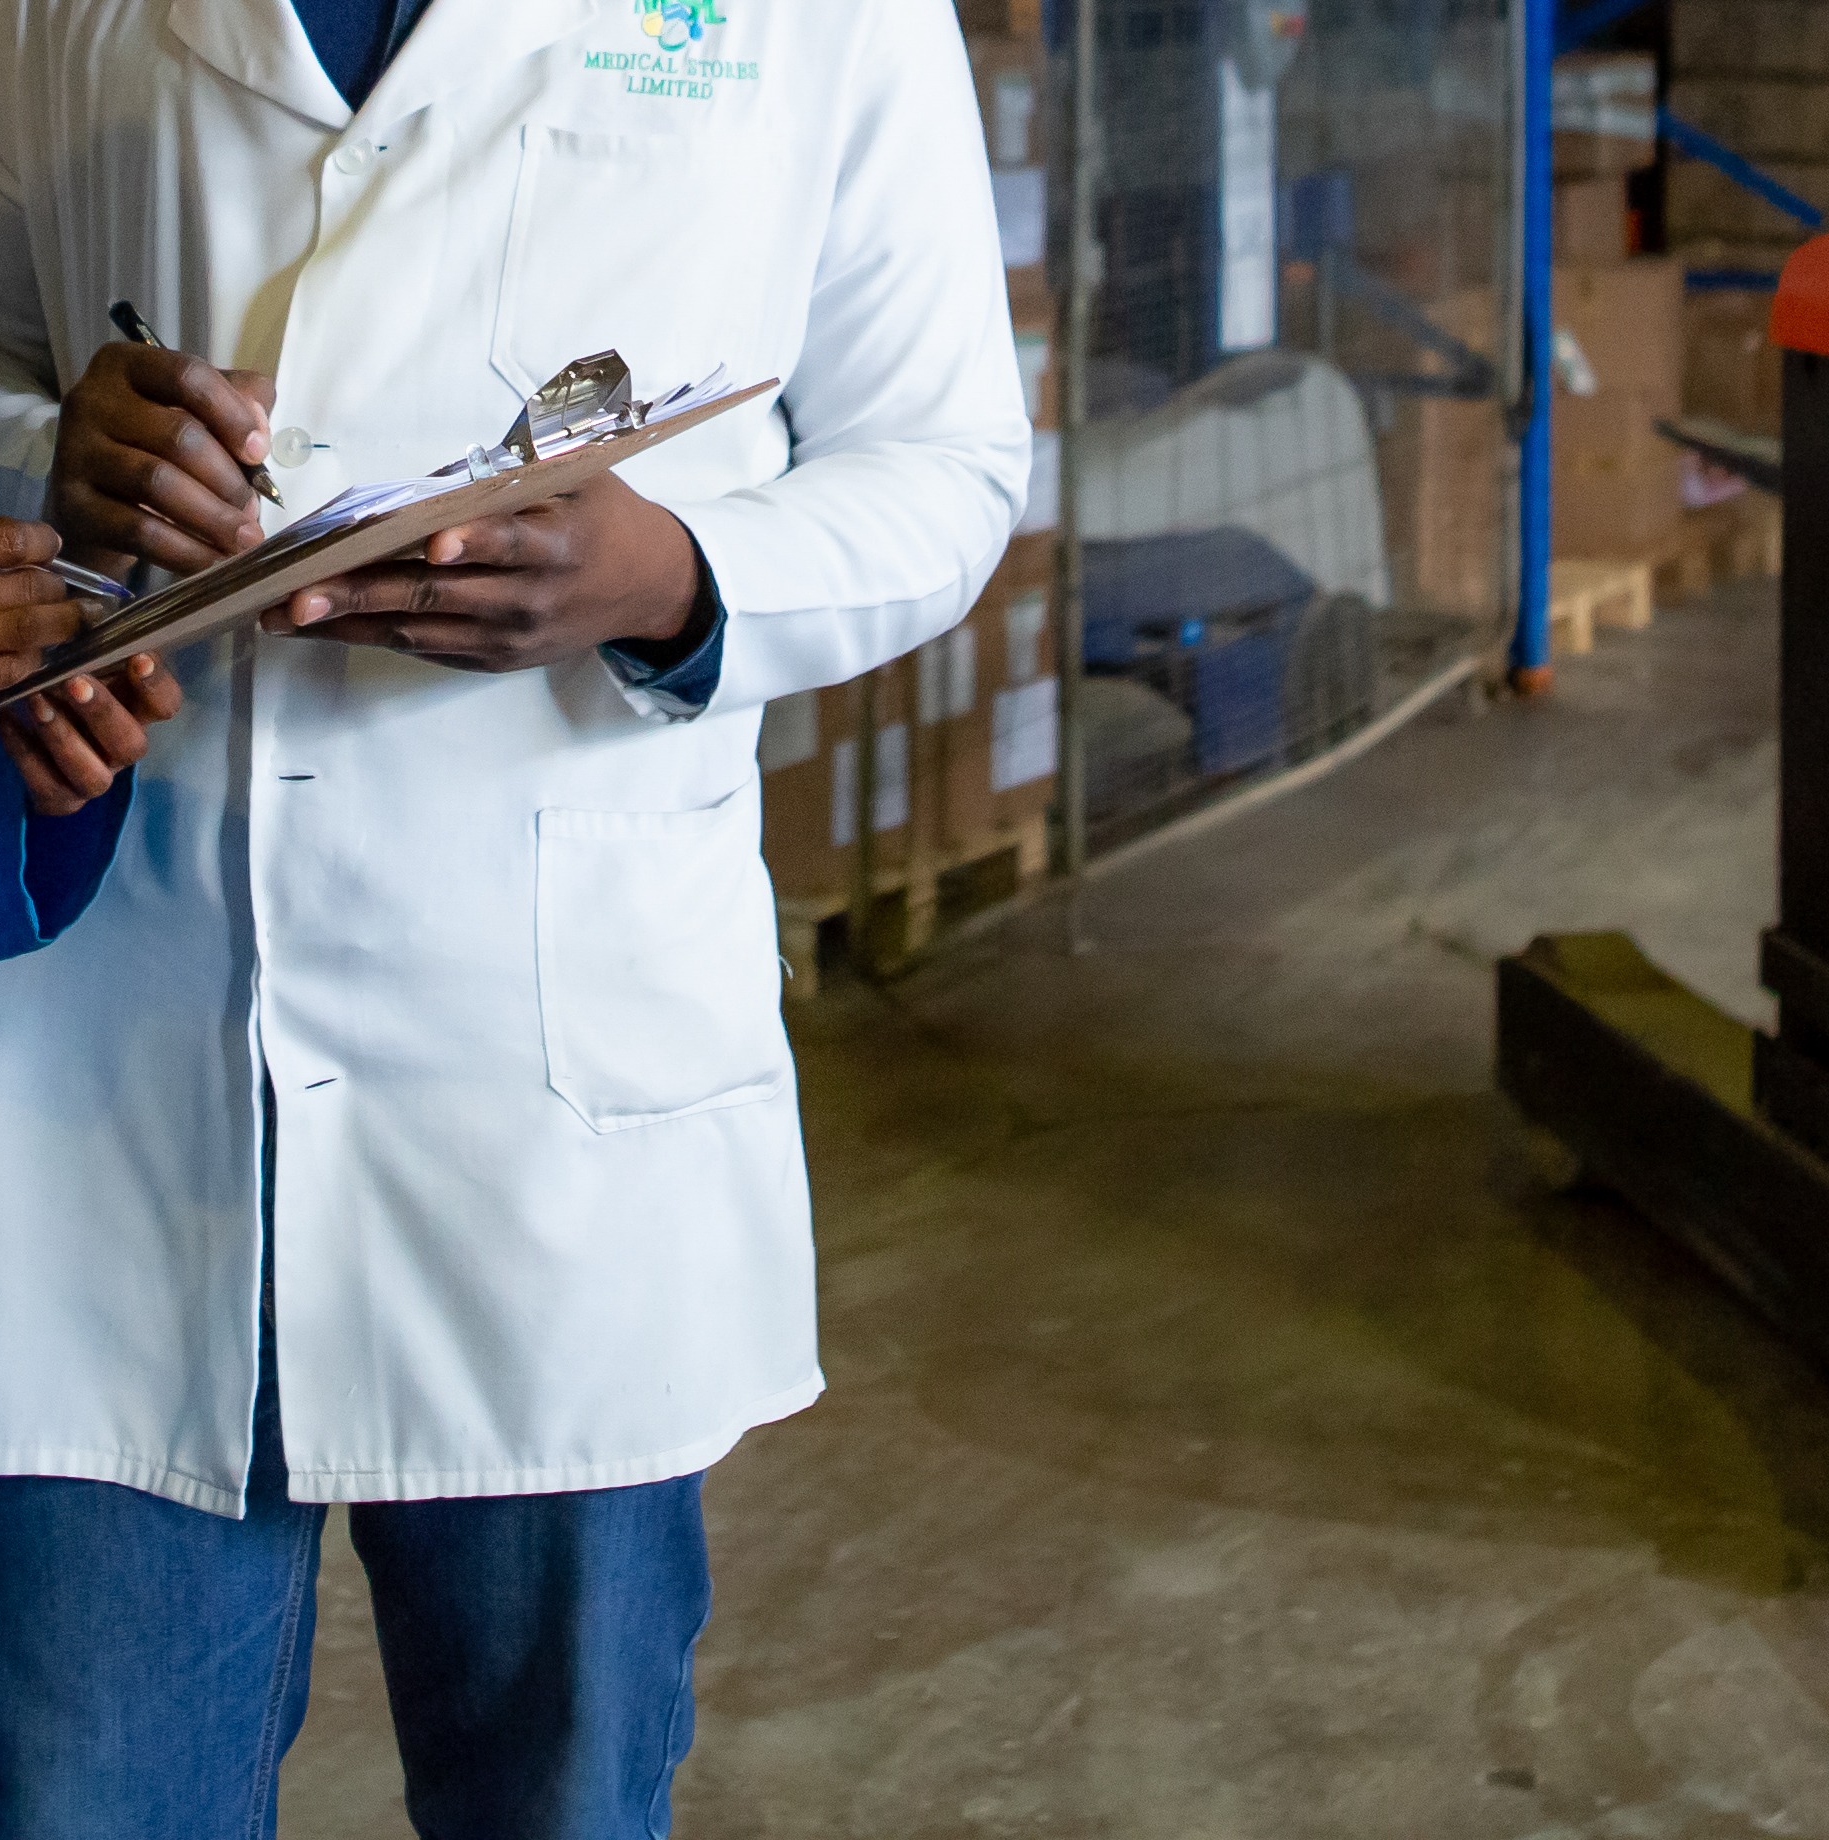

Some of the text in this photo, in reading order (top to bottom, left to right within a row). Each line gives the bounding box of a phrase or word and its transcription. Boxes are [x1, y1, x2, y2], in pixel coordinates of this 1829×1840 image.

[583, 50, 760, 80] MEDICAL STORES
[626, 75, 714, 100] LIMITED
